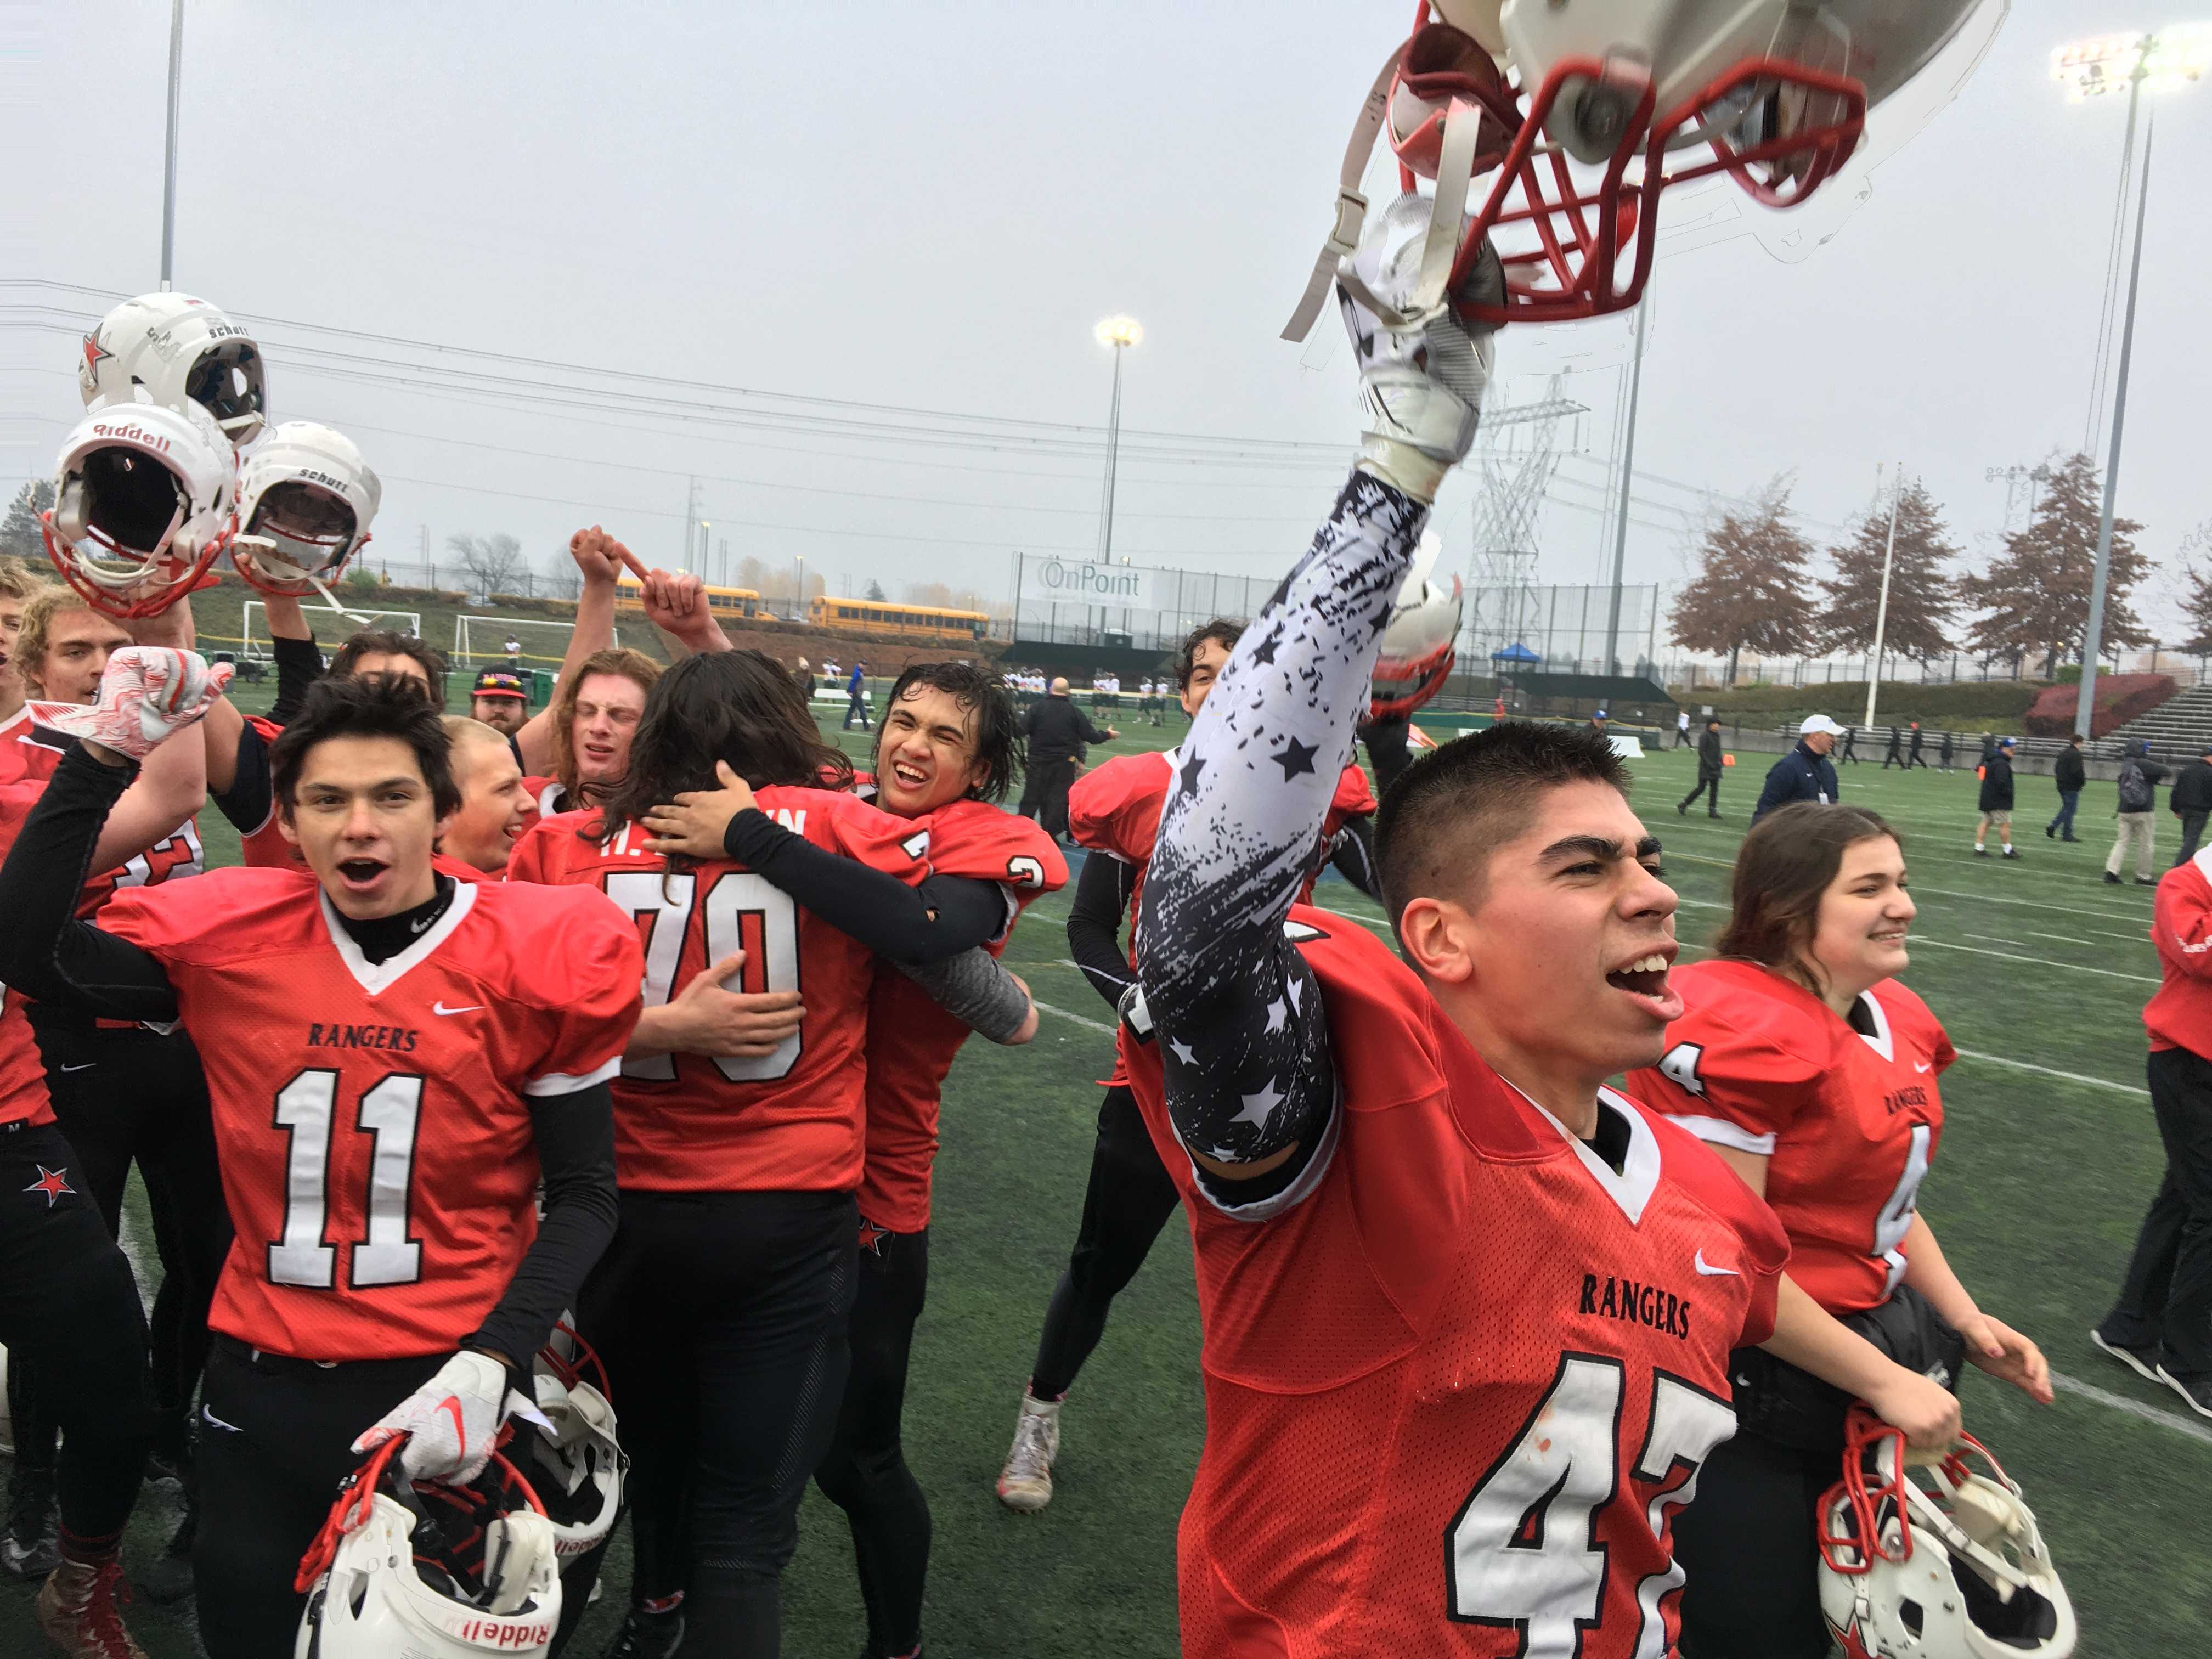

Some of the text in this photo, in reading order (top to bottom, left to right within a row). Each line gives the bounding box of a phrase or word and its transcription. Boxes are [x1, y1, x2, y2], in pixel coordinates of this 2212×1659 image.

[208, 325, 249, 339] schutt
[93, 424, 171, 452] Riddell
[300, 469, 348, 492] schutt
[1044, 561, 1139, 596] OnPoint
[604, 870, 803, 1082] 70
[307, 1023, 419, 1052] RANGERS
[1657, 1040, 1705, 1097] 4
[266, 1067, 426, 1290] 11
[1578, 1273, 1690, 1340] RANGERS
[462, 1621, 550, 1648] Riddell
